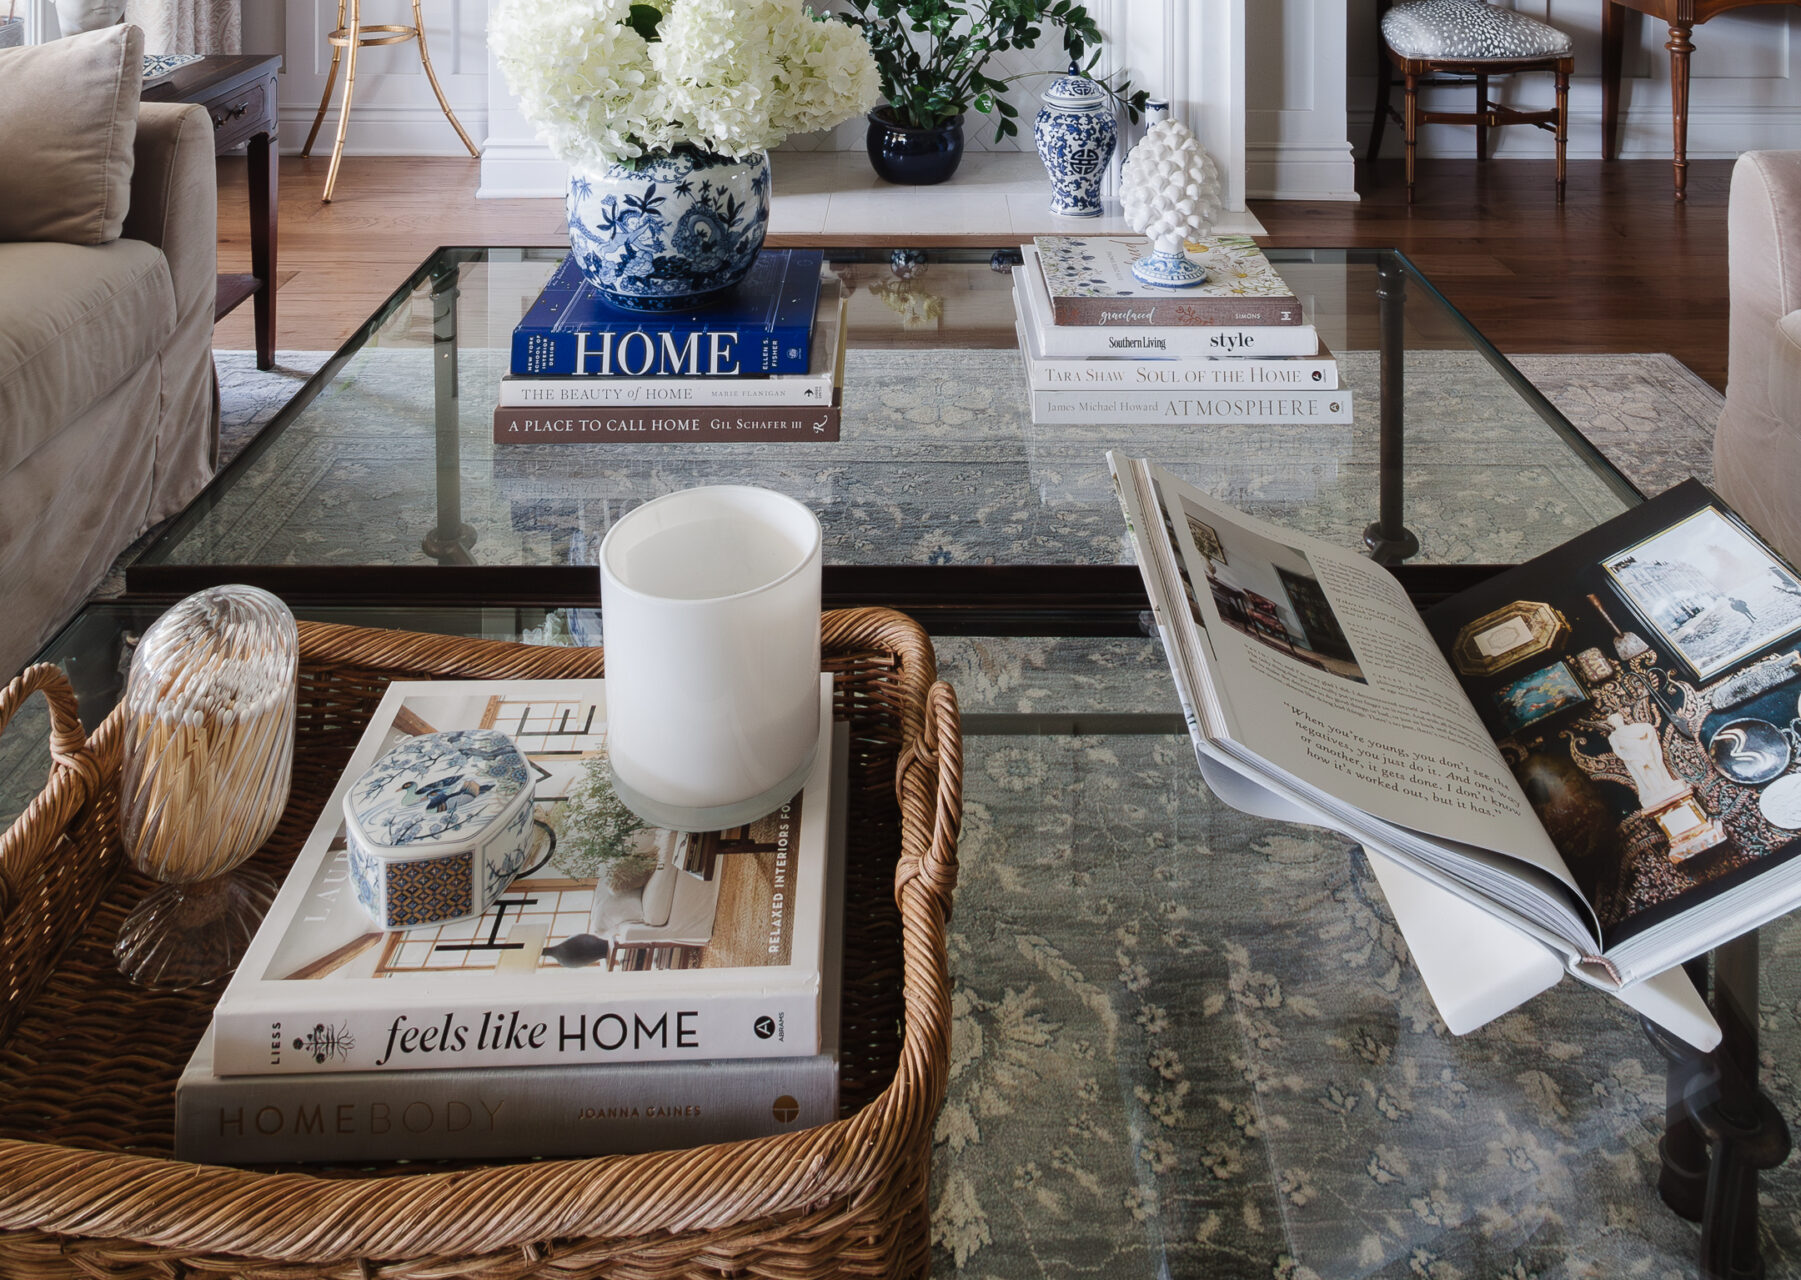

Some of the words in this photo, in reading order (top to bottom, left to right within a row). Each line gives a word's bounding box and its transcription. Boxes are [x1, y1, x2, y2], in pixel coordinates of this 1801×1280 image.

[536, 335, 541, 343] OF
[1108, 336, 1142, 349] Southern
[1143, 336, 1167, 350] Living
[1210, 332, 1254, 352] style
[572, 331, 740, 376] HOME
[1045, 368, 1081, 382] TARA
[1085, 368, 1126, 382] SHAW
[1136, 367, 1180, 383] SOUL
[1184, 370, 1207, 383] OF
[1213, 370, 1244, 383] THE
[1250, 367, 1302, 383] HOME
[521, 388, 555, 400] THE
[560, 388, 623, 401] BEAUTY
[627, 386, 642, 401] of
[646, 387, 693, 400] HOME
[1047, 401, 1075, 413] James
[1079, 401, 1117, 412] Michael
[1120, 401, 1159, 412] Howard
[1165, 399, 1319, 416] ATMOSPHERE
[508, 420, 519, 432] A
[524, 420, 574, 432] PLACE
[578, 420, 602, 432] TO
[606, 419, 647, 432] CALL
[651, 419, 700, 431] HOME
[710, 419, 732, 430] GIL
[736, 418, 788, 430] SCHAFER
[791, 421, 802, 429] III
[1283, 701, 1325, 728] "When
[1327, 725, 1365, 743] you're
[1367, 739, 1410, 758] young,
[1412, 752, 1436, 763] you
[1439, 757, 1470, 773] don't
[1473, 769, 1491, 781] see
[1493, 777, 1511, 792] the
[1295, 721, 1354, 753] negatives,
[1357, 748, 1380, 760] you
[1382, 753, 1405, 768] just
[1409, 761, 1424, 773] do
[1427, 765, 1442, 777] it.
[1445, 771, 1471, 785] And
[1474, 781, 1495, 793] one
[1497, 790, 1520, 808] way
[1300, 735, 1312, 744] or
[1315, 743, 1365, 769] another,
[1368, 761, 1378, 772] it
[1381, 768, 1405, 781] gets
[1409, 774, 1443, 790] done.
[1447, 783, 1452, 792] I
[1455, 785, 1488, 802] don't
[1491, 795, 1521, 817] know
[1307, 747, 1330, 765] how
[1334, 759, 1352, 776] it's
[1355, 771, 1399, 792] worked
[1402, 787, 1429, 801] out,
[1432, 791, 1454, 806] but
[1457, 798, 1467, 809] it
[1470, 801, 1502, 818] has."
[780, 799, 792, 819] FO
[774, 823, 790, 888] INTERIORS
[769, 892, 784, 953] RELAXED
[271, 1022, 281, 1065] LIESS
[377, 1012, 469, 1066] feels
[477, 1010, 548, 1051] like
[559, 1010, 700, 1052] HOME
[219, 1099, 505, 1136] HOMEBODY
[578, 1106, 640, 1120] JOANNA
[645, 1105, 702, 1117] GAINES
